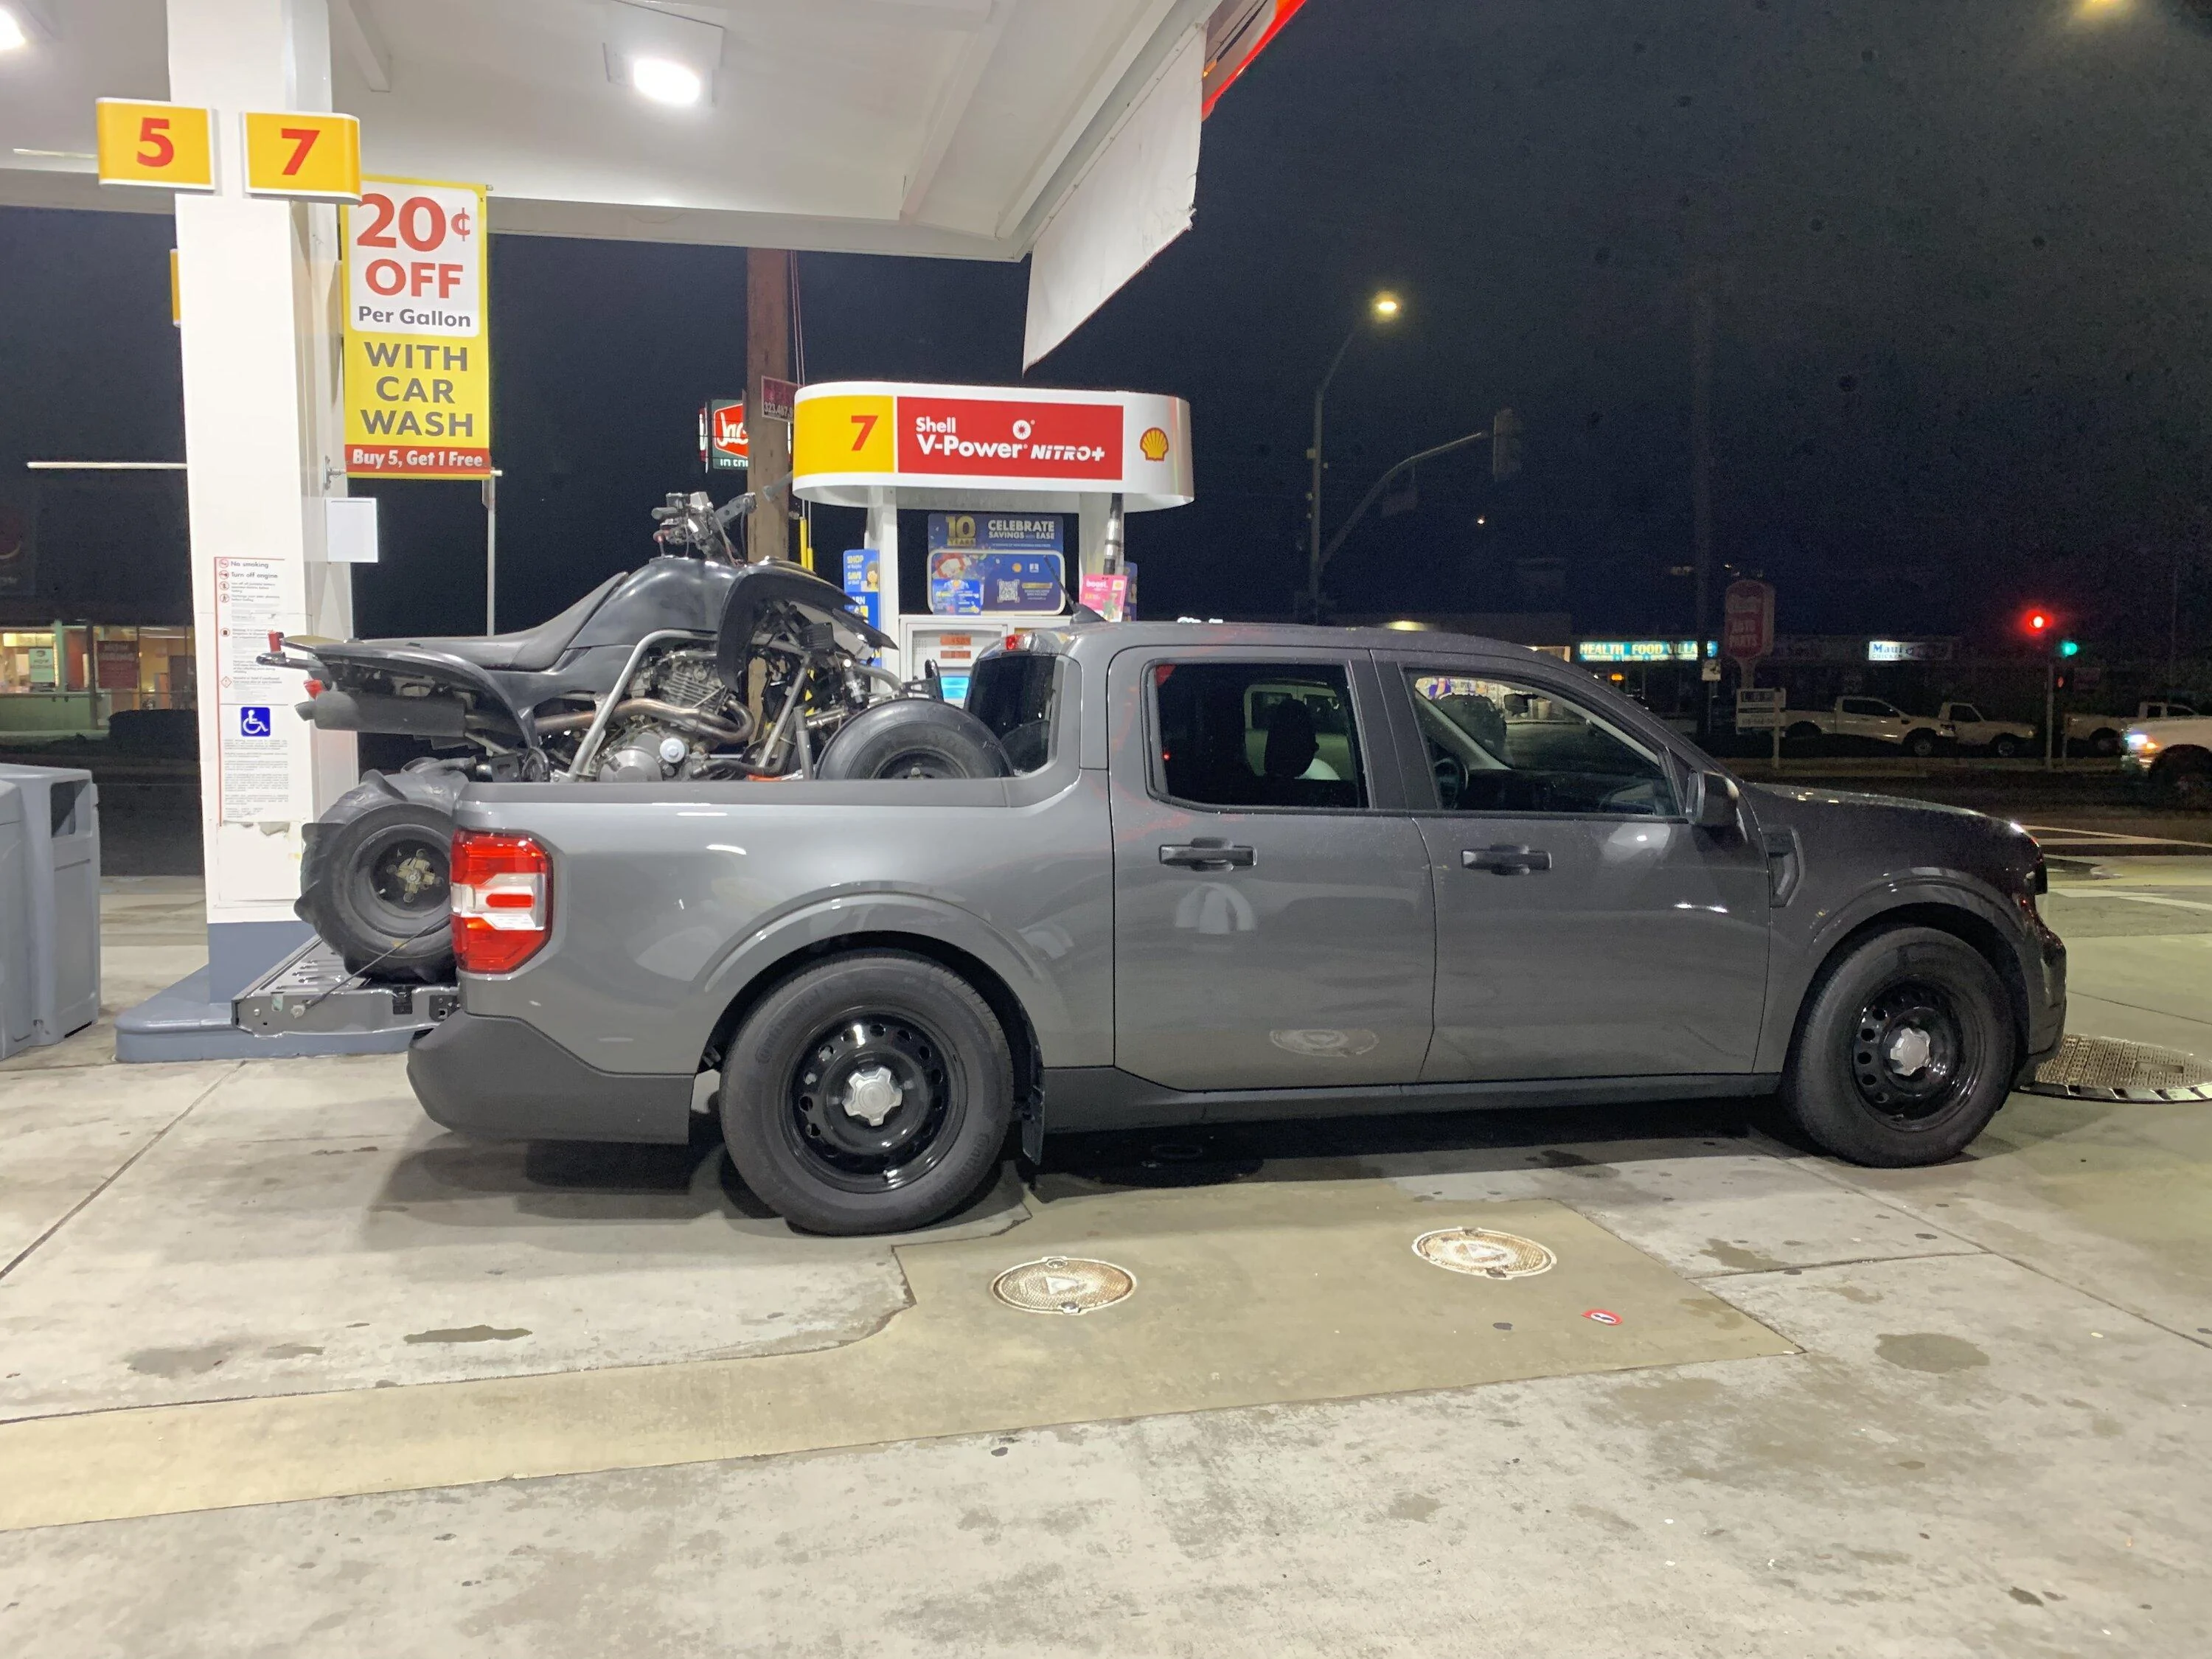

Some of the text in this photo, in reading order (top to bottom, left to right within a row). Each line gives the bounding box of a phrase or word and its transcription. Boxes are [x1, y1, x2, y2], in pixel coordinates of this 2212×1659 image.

[136, 117, 175, 167] 5
[280, 128, 321, 175] 7
[365, 259, 464, 299] OFF
[358, 306, 470, 327] Per Gallon
[364, 341, 467, 372] WITH
[376, 376, 455, 403] CAR
[360, 409, 473, 437] WASH
[716, 411, 748, 447] Jac
[850, 414, 878, 451] 7
[916, 416, 956, 434] Shell
[352, 448, 483, 469] Buy 5, Get 1 Free
[916, 434, 1023, 459] V-Power
[945, 516, 976, 538] 10
[987, 519, 1054, 532] CELEBRATE
[988, 531, 1025, 539] SAVINGS
[1036, 532, 1054, 540] EASE
[1580, 643, 1624, 654] HEALTH
[1632, 643, 1663, 654] FOOD
[1873, 643, 1903, 653] Maui
